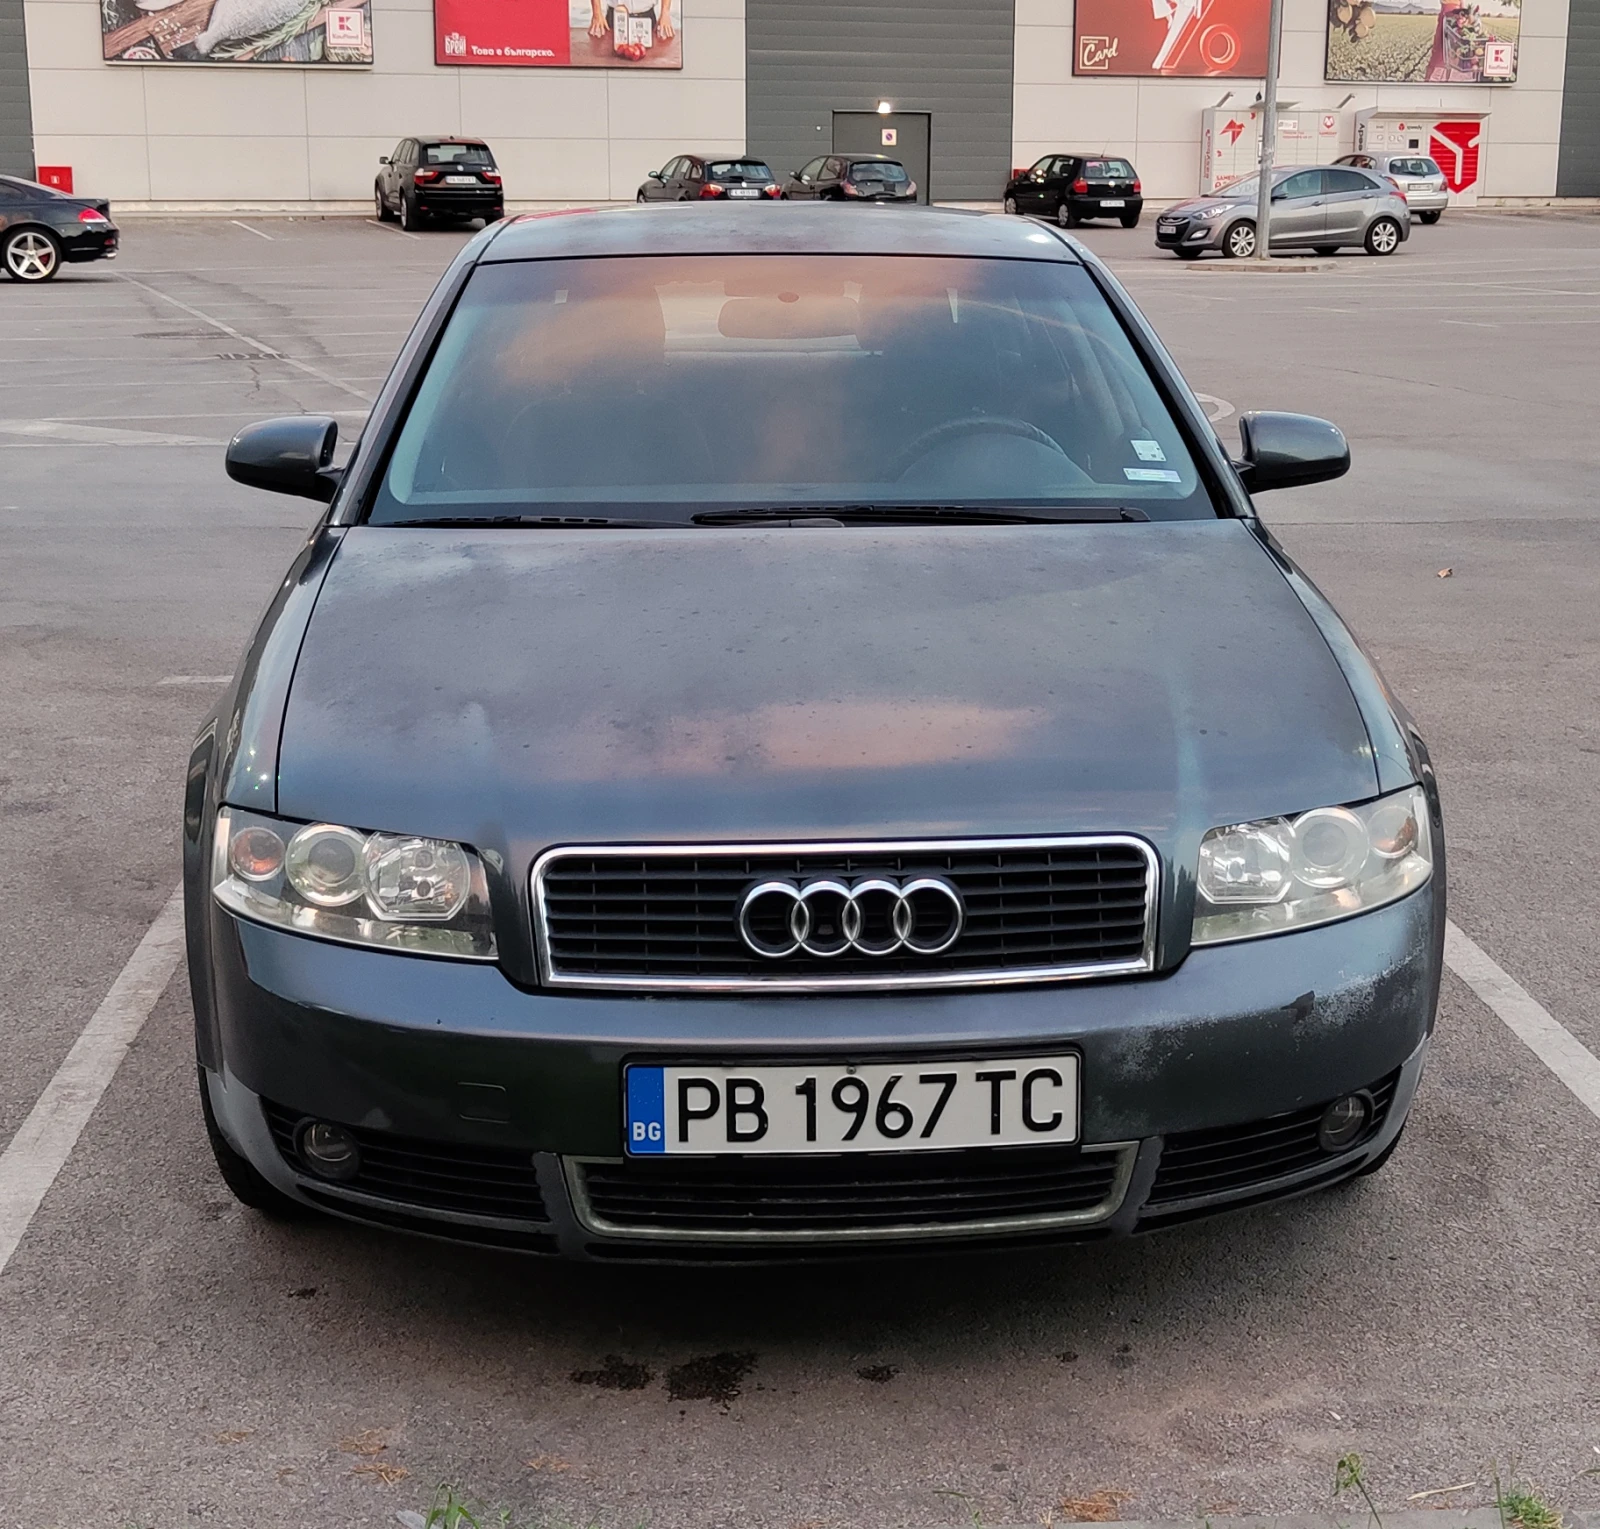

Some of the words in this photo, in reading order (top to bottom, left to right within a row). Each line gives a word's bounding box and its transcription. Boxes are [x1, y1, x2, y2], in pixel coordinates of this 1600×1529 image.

[471, 45, 494, 55] Това
[504, 46, 555, 58] българско.
[1083, 37, 1118, 65] Card
[1358, 123, 1366, 151] eedy
[677, 1077, 769, 1143] PB
[795, 1073, 958, 1142] 1967
[975, 1068, 1064, 1135] TC
[632, 1121, 662, 1142] BG
